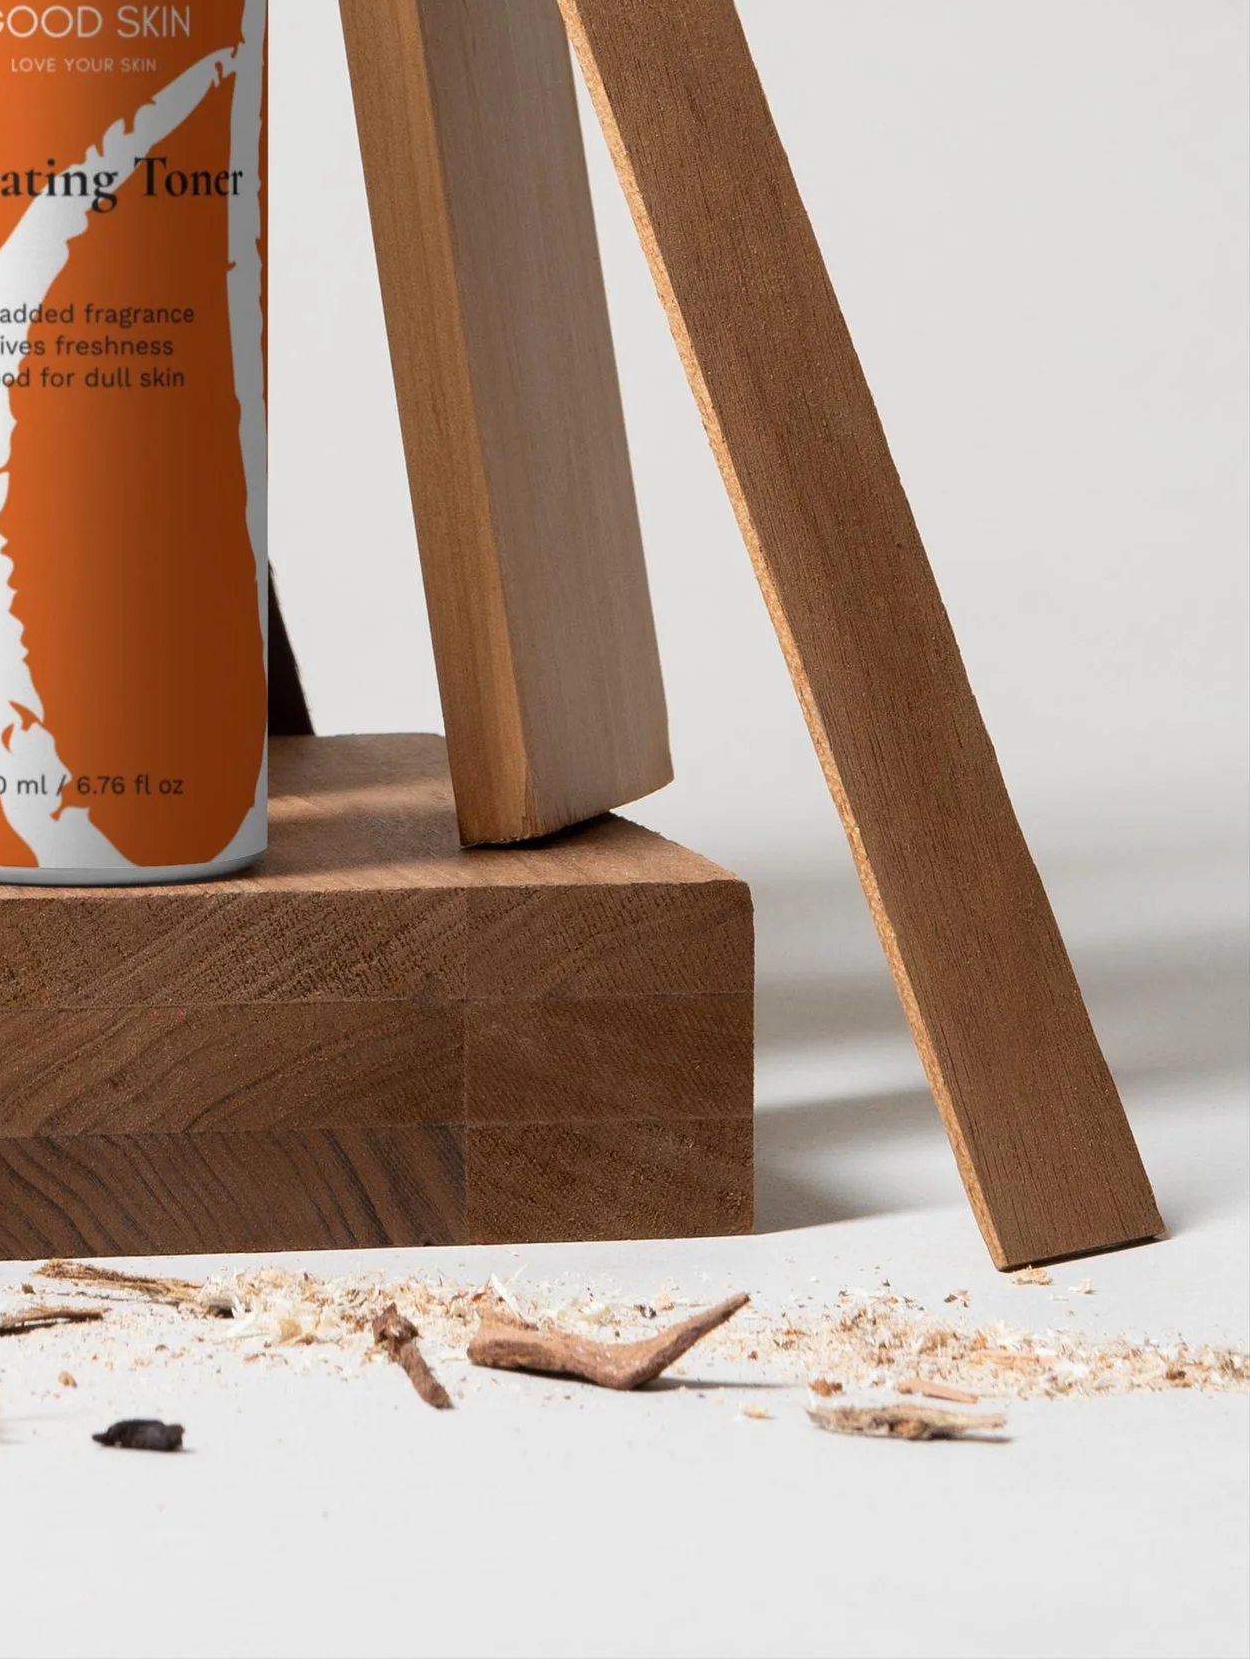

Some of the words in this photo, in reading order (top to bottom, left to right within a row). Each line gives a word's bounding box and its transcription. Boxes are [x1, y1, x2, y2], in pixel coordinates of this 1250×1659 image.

[117, 5, 191, 38] SKIN
[10, 57, 56, 73] LOVE
[64, 57, 114, 73] YOUR
[120, 57, 157, 73] SKIN
[134, 157, 244, 197] Toner
[0, 303, 75, 324] added
[84, 303, 195, 329] fragrance
[55, 335, 174, 356] freshness
[40, 367, 76, 388] for
[84, 367, 132, 388] dull
[139, 367, 185, 388] skin
[16, 774, 47, 795] ml
[55, 774, 67, 797] /
[76, 775, 125, 795] 6.76
[134, 774, 151, 795] fl
[158, 780, 184, 795] oz
